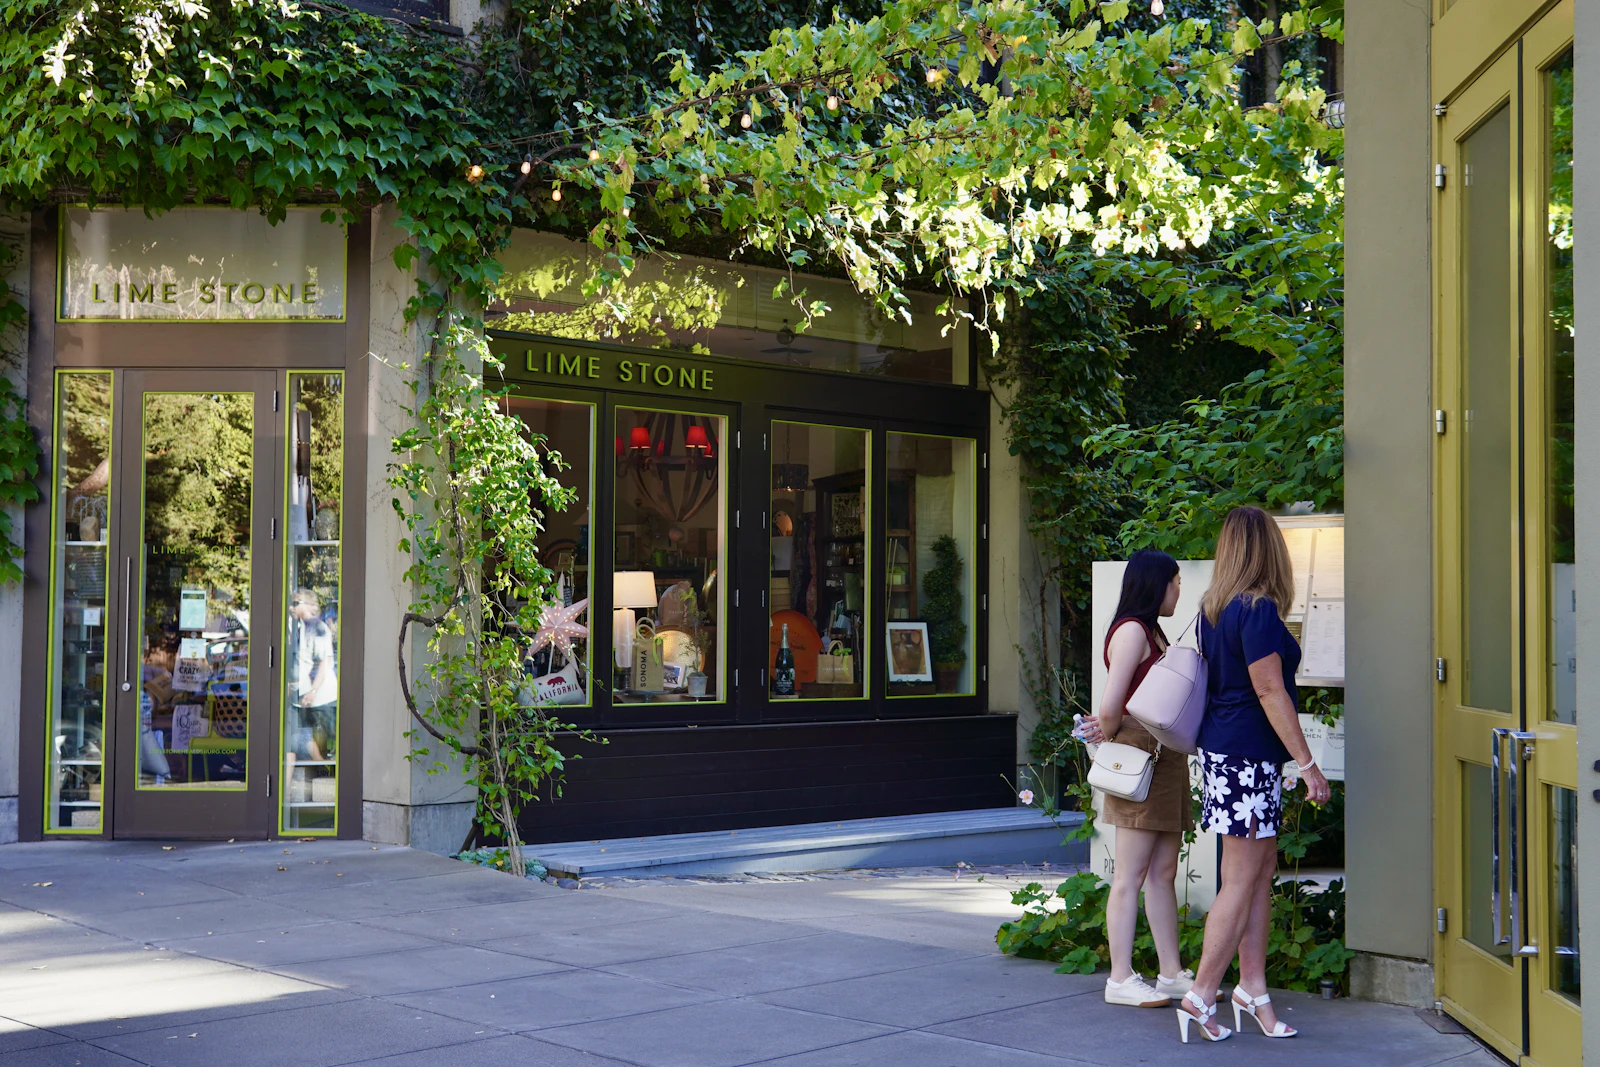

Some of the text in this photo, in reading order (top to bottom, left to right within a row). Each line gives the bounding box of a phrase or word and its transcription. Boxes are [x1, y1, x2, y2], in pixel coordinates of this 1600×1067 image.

[92, 282, 319, 304] LIME STONE
[525, 349, 714, 391] LIME STONE
